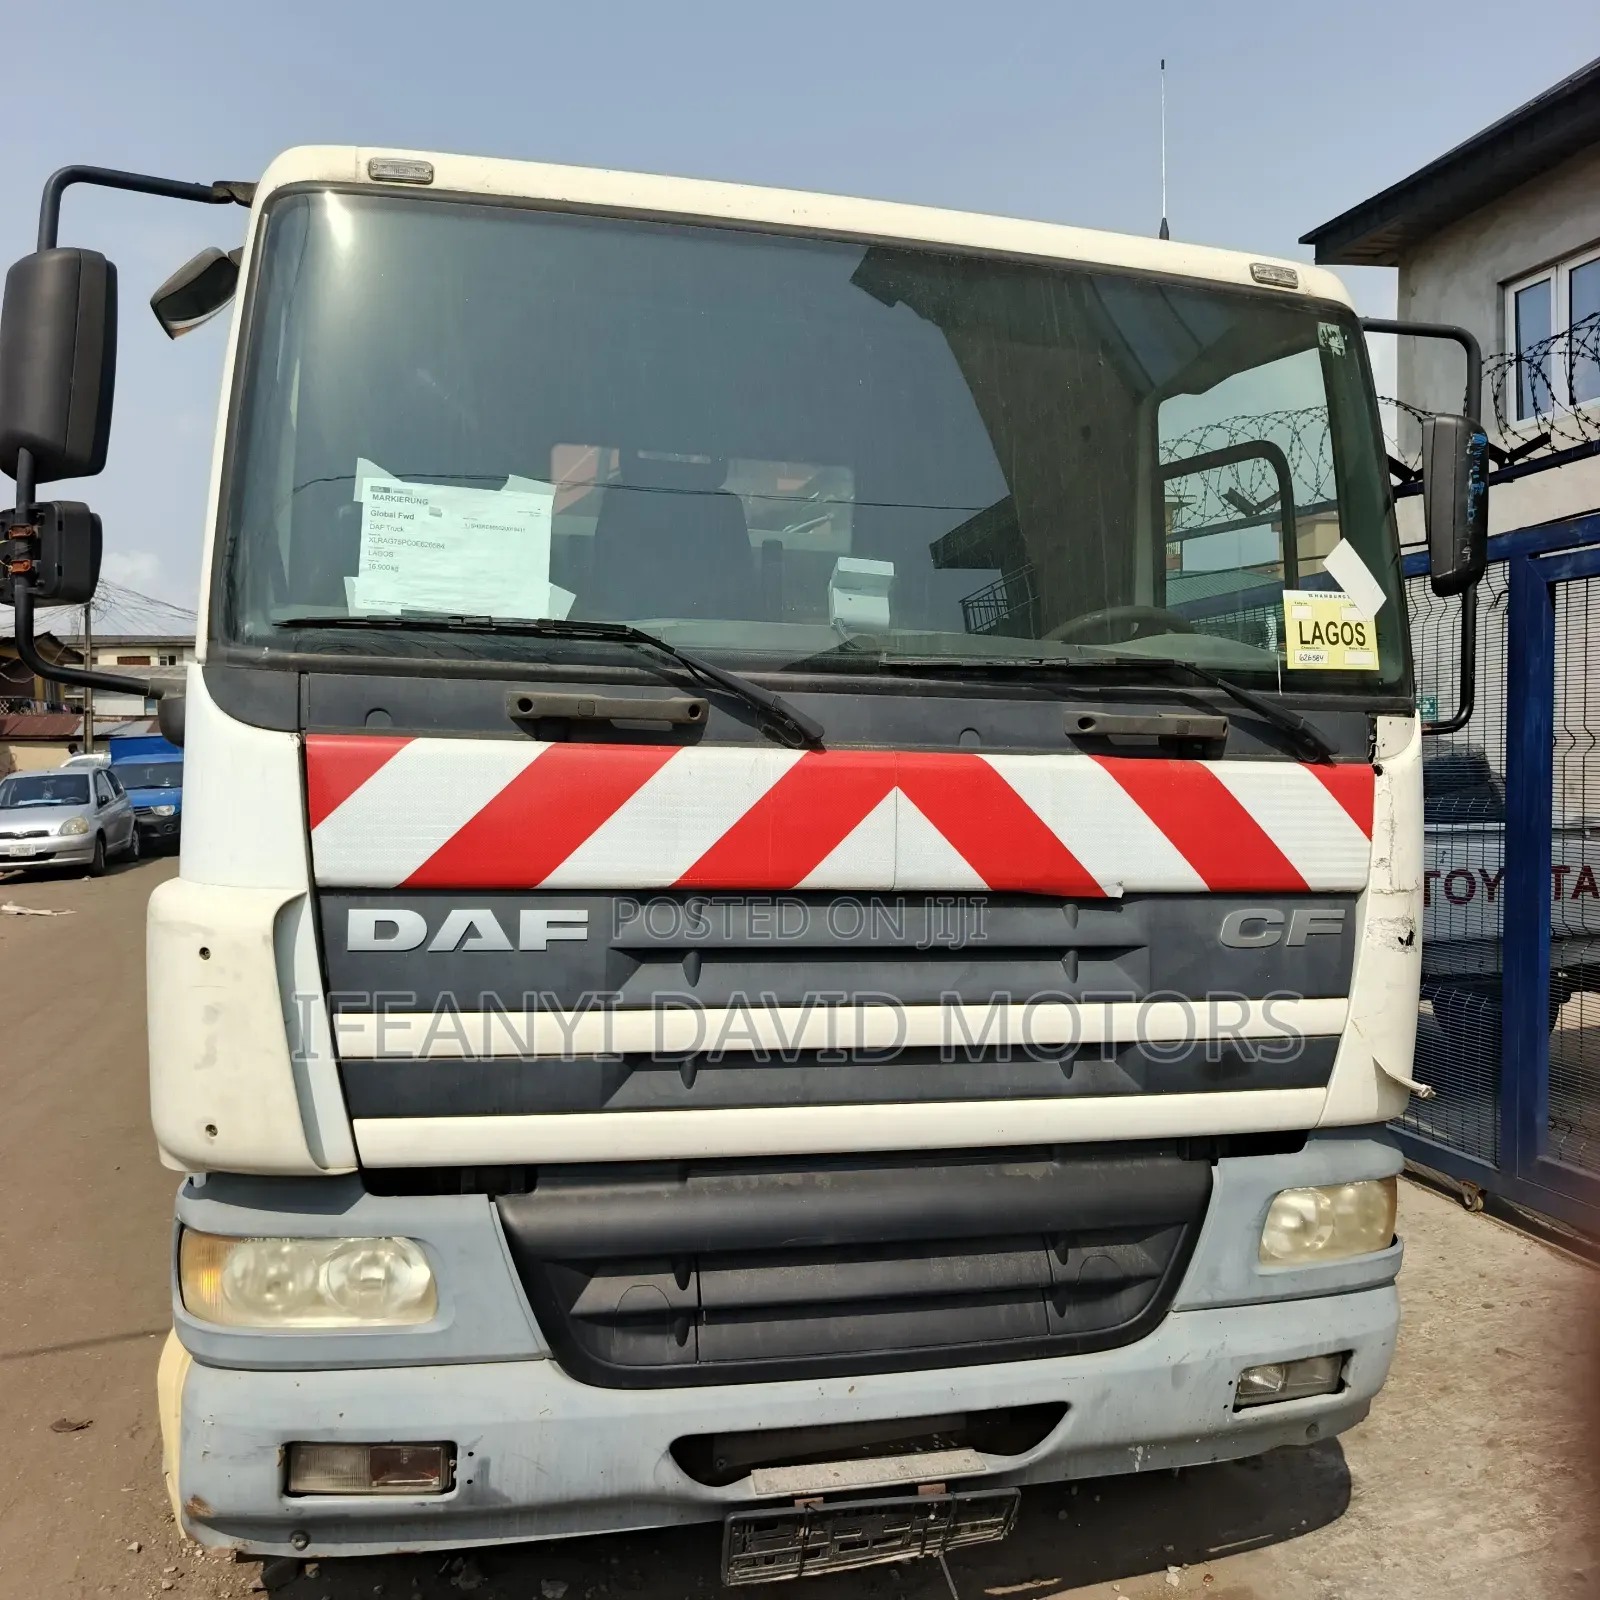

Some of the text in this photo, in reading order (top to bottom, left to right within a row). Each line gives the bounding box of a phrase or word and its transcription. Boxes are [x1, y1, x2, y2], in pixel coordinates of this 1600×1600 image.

[372, 494, 429, 505] MARKIERUNG
[370, 509, 415, 521] Global Fwd
[369, 523, 404, 533] DAF Truck
[368, 549, 394, 558] LAGOS
[1299, 621, 1366, 646] LAGOS
[1424, 865, 1600, 907] TOYTA
[347, 909, 590, 952] DAF
[1219, 908, 1346, 948] CF
